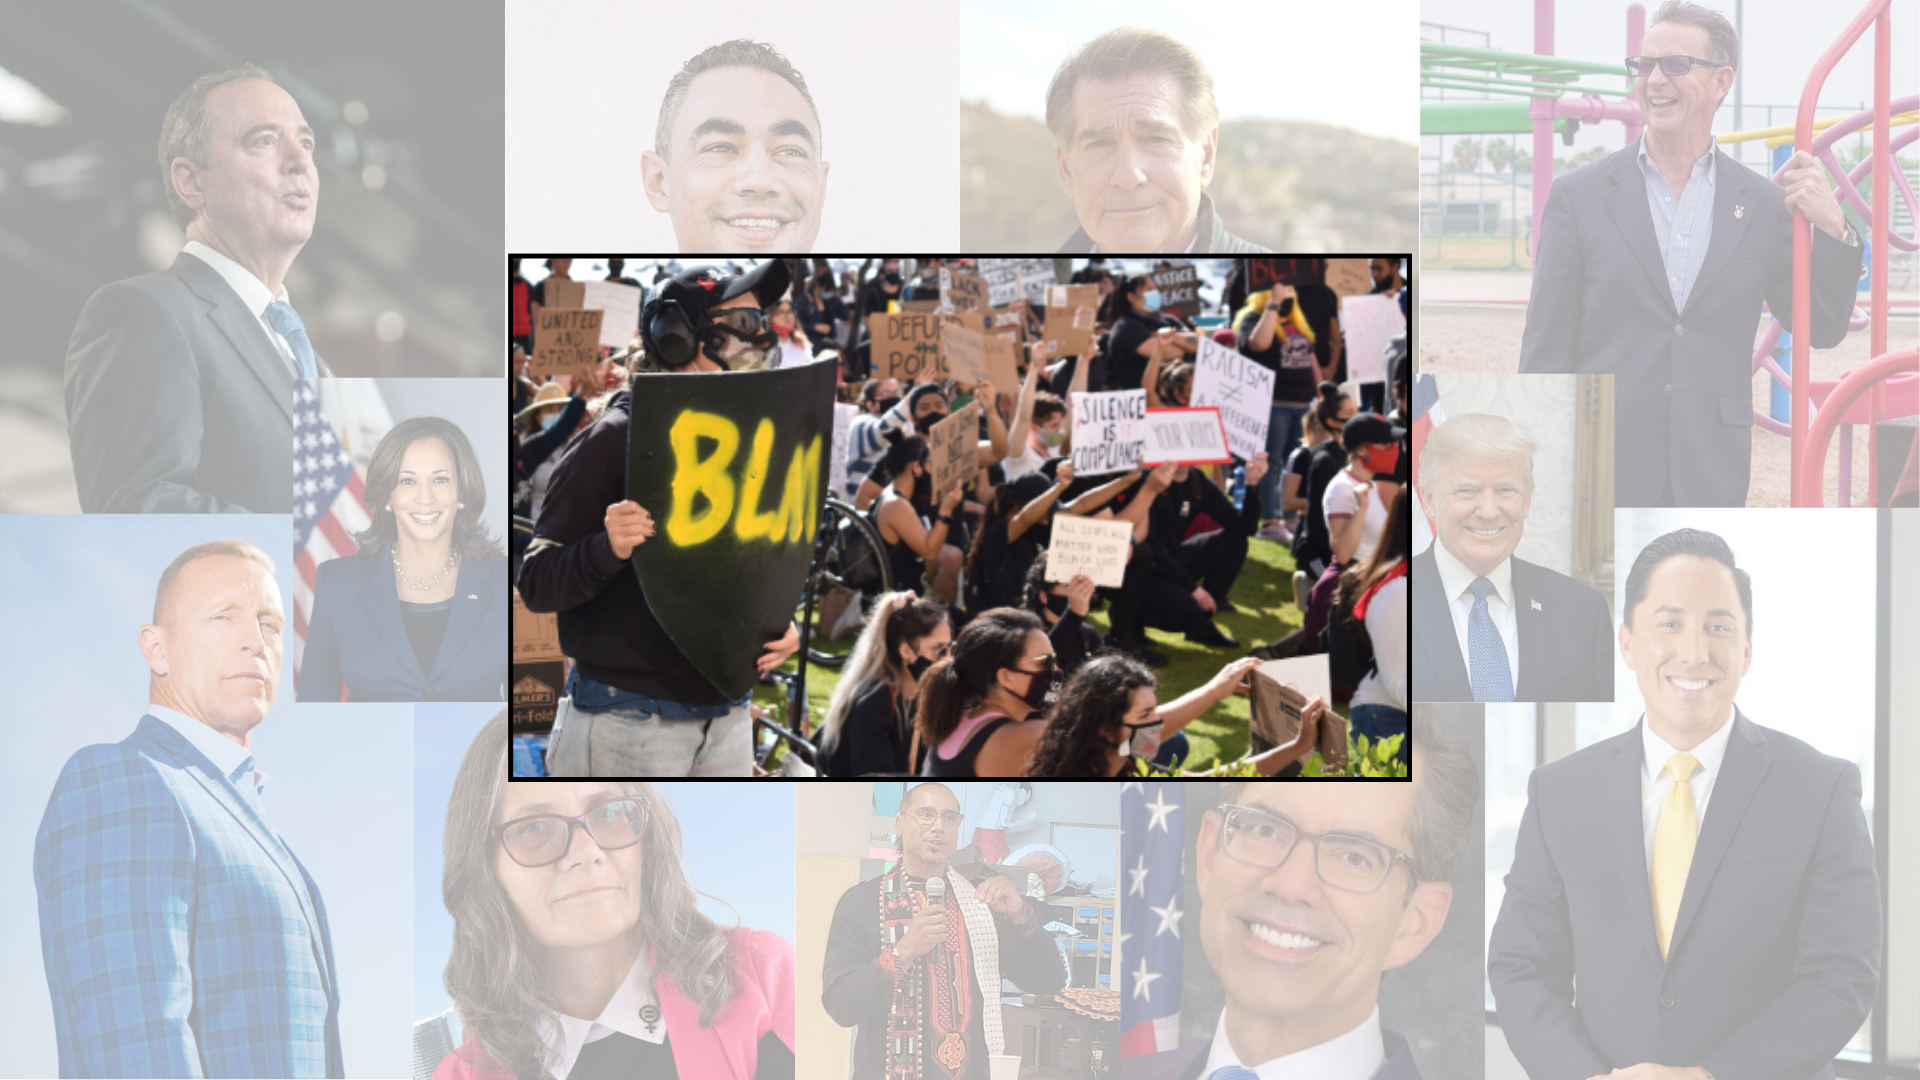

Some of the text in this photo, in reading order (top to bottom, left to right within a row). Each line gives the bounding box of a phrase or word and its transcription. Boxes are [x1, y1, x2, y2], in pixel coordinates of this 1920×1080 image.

[951, 275, 981, 298] LACK
[542, 310, 600, 330] UNITED
[554, 329, 584, 348] AND
[537, 347, 594, 367] STRONG
[890, 351, 950, 377] POLIC
[1201, 340, 1270, 398] RACISM
[1081, 396, 1146, 425] SILENCE
[1104, 424, 1117, 443] IS
[1073, 440, 1144, 473] COMPLIANCE
[666, 409, 822, 547] BLM
[513, 708, 554, 724] ri-Fold
